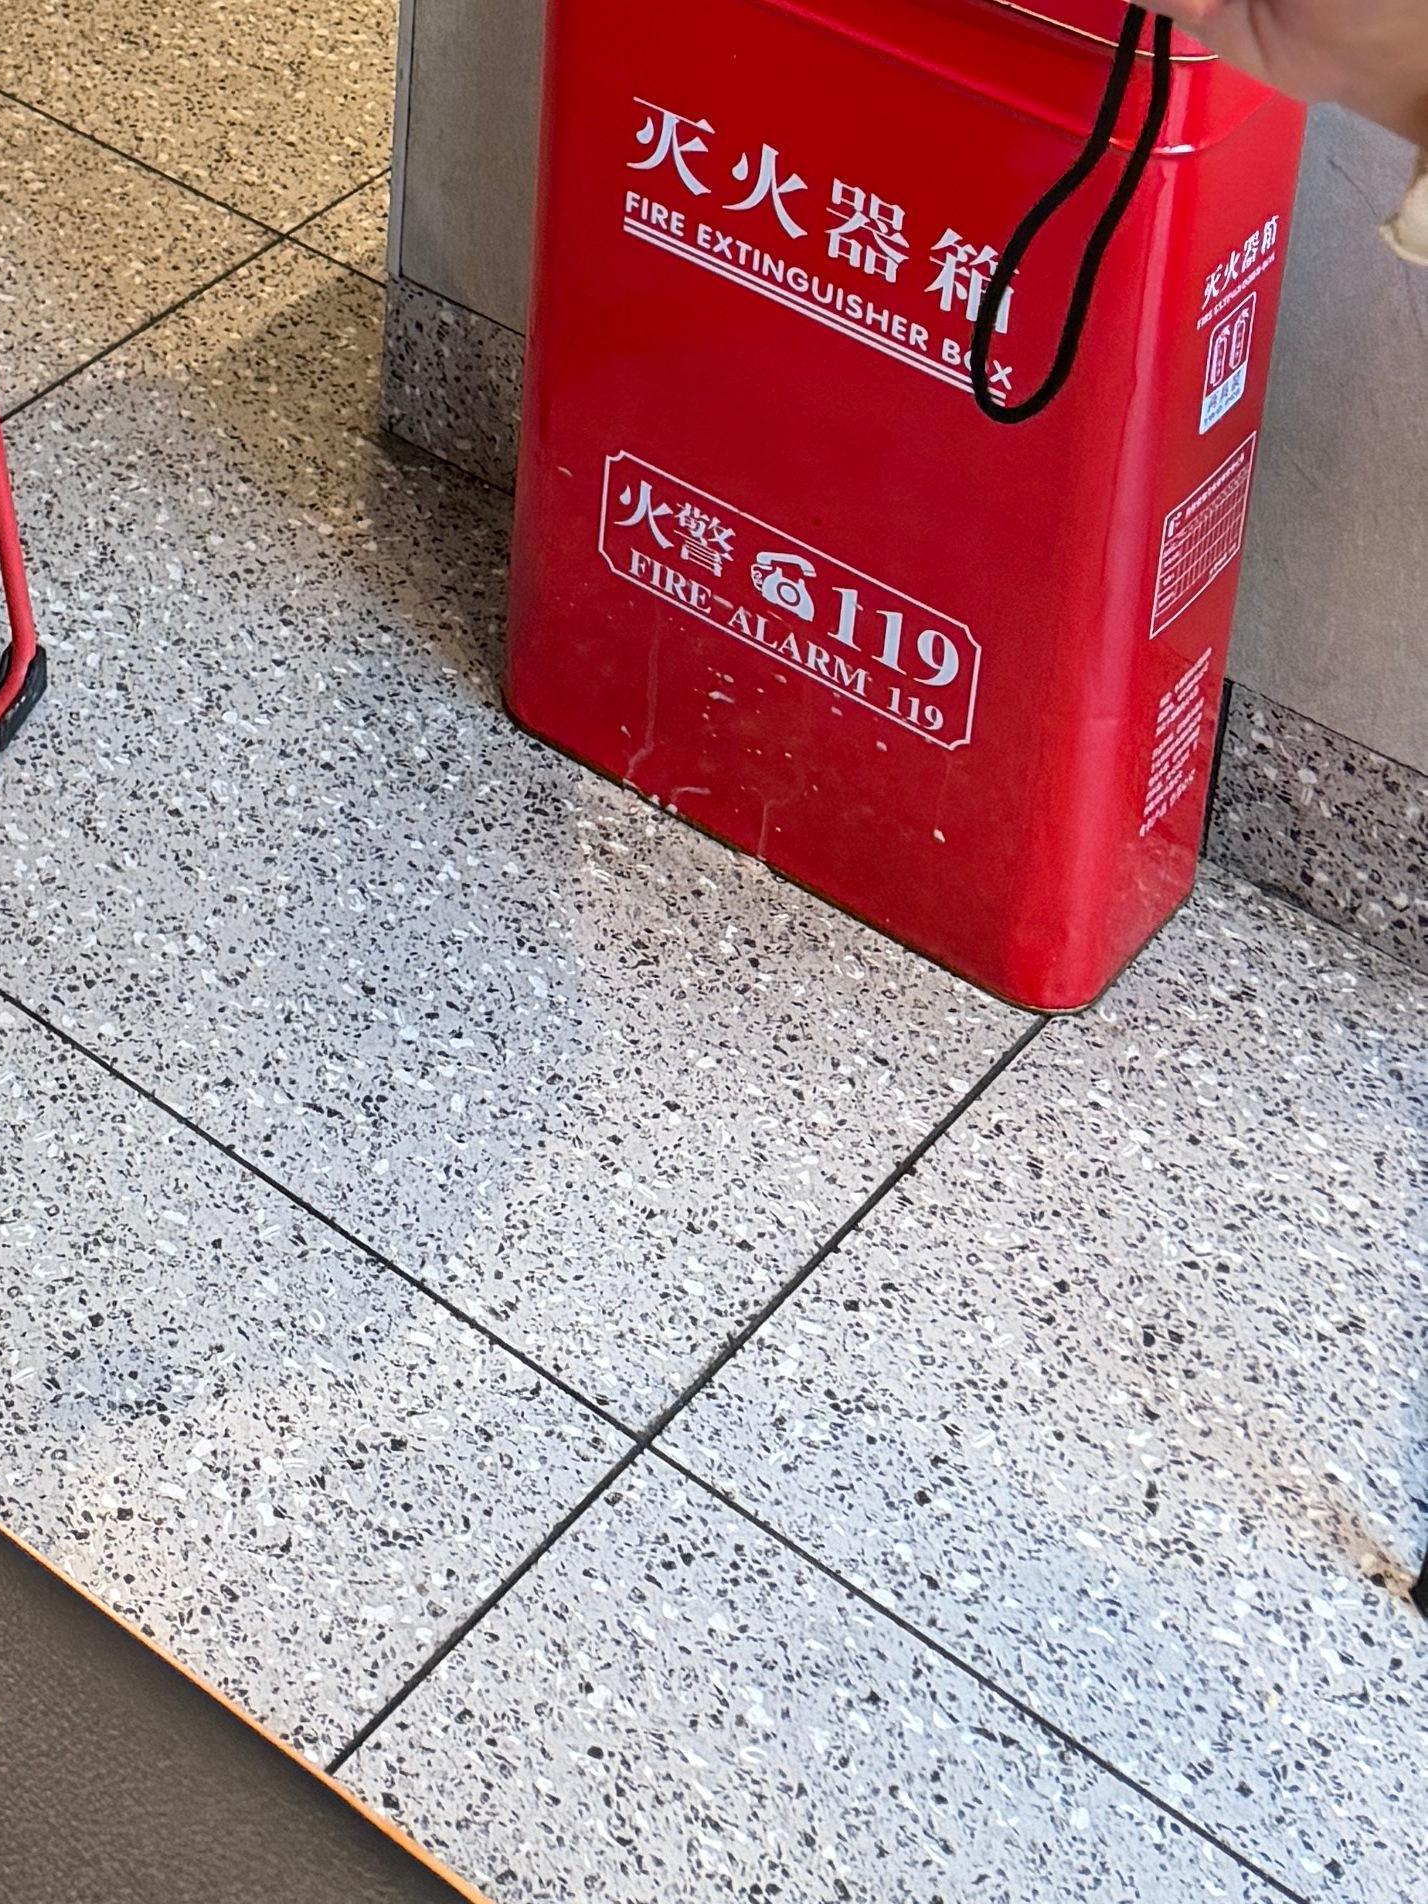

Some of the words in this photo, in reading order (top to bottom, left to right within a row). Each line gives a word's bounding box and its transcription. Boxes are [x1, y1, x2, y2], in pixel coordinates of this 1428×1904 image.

[625, 190, 686, 236] FIRE
[696, 225, 929, 352] EXTINGUISHER
[626, 96, 1020, 335] 灭火器箱
[613, 479, 737, 578] 火警
[827, 586, 960, 687] 119
[628, 547, 713, 615] FIRE
[726, 605, 869, 696] ALARM
[886, 686, 944, 731] 119
